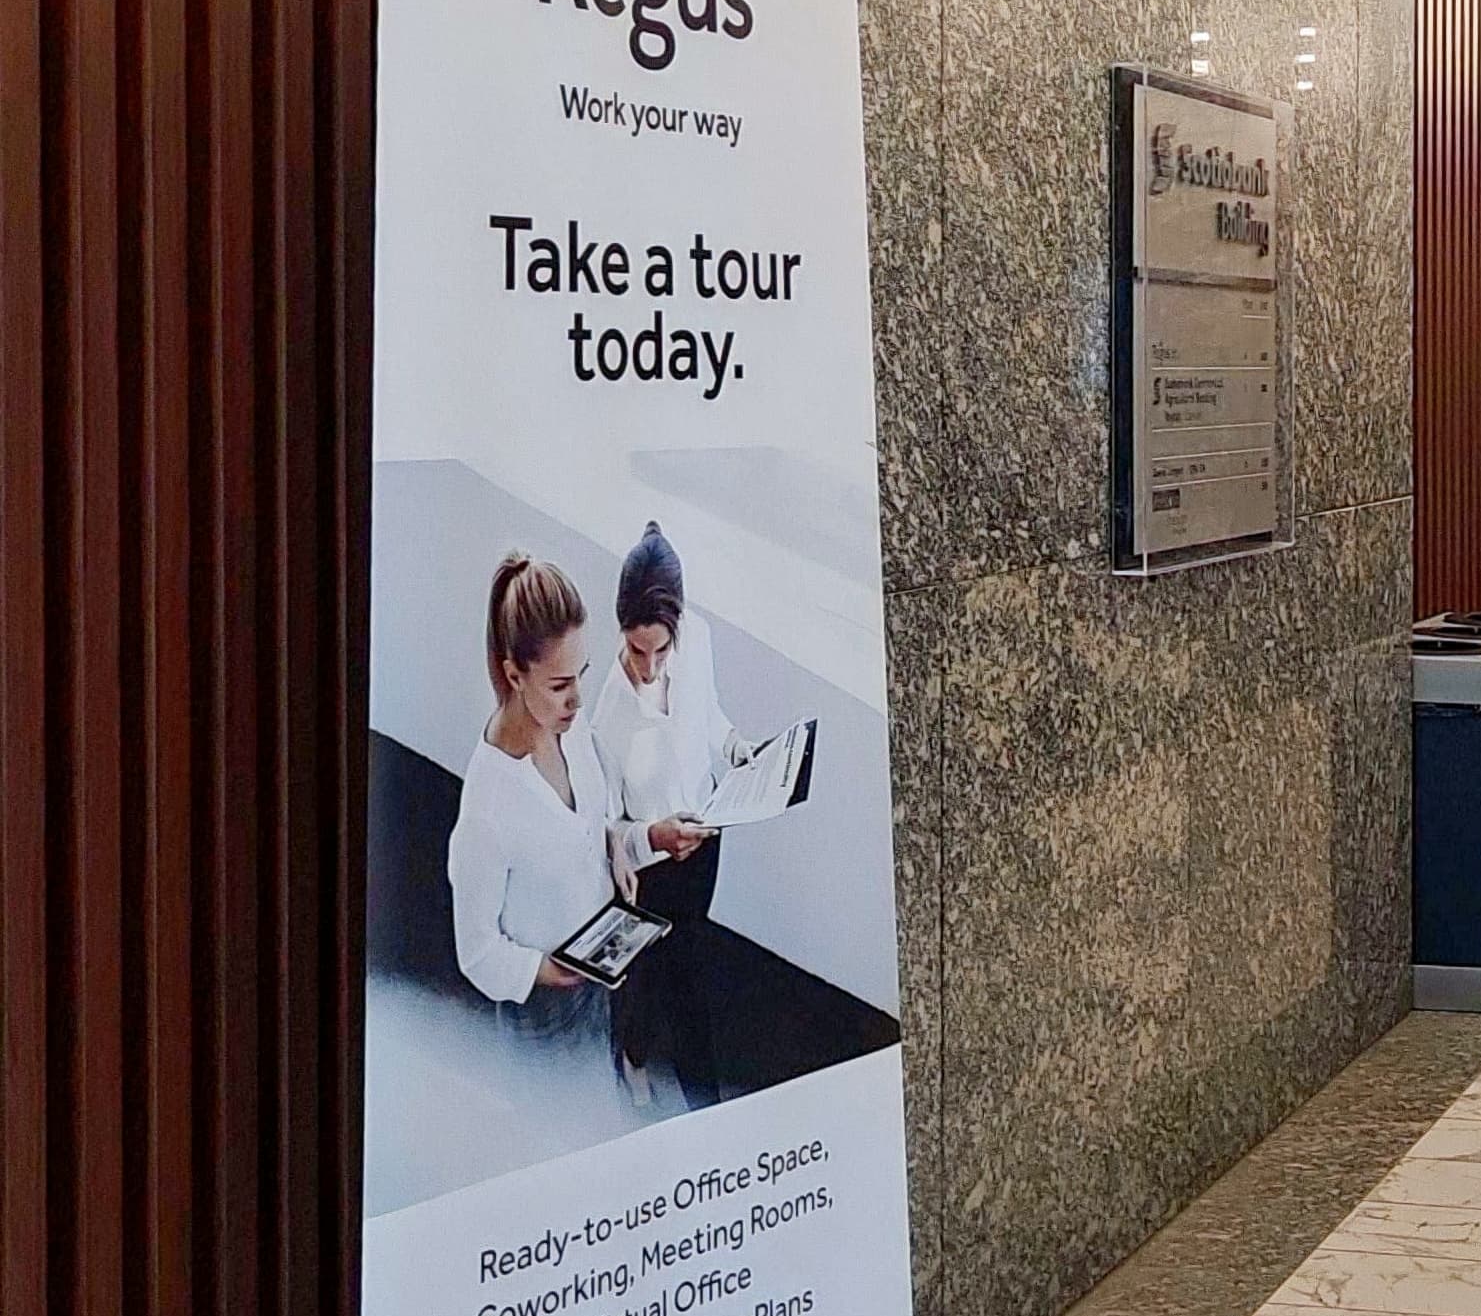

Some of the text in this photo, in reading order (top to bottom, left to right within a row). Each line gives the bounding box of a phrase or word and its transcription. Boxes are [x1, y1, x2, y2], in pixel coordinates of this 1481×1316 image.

[559, 84, 742, 146] Work your way
[489, 214, 801, 301] Take a tour
[568, 310, 743, 400] today.
[479, 1137, 829, 1283] Ready-to-use Office Space,
[641, 1217, 744, 1277] Meeting
[751, 1185, 833, 1240] Rooms,
[675, 1265, 752, 1311] Office
